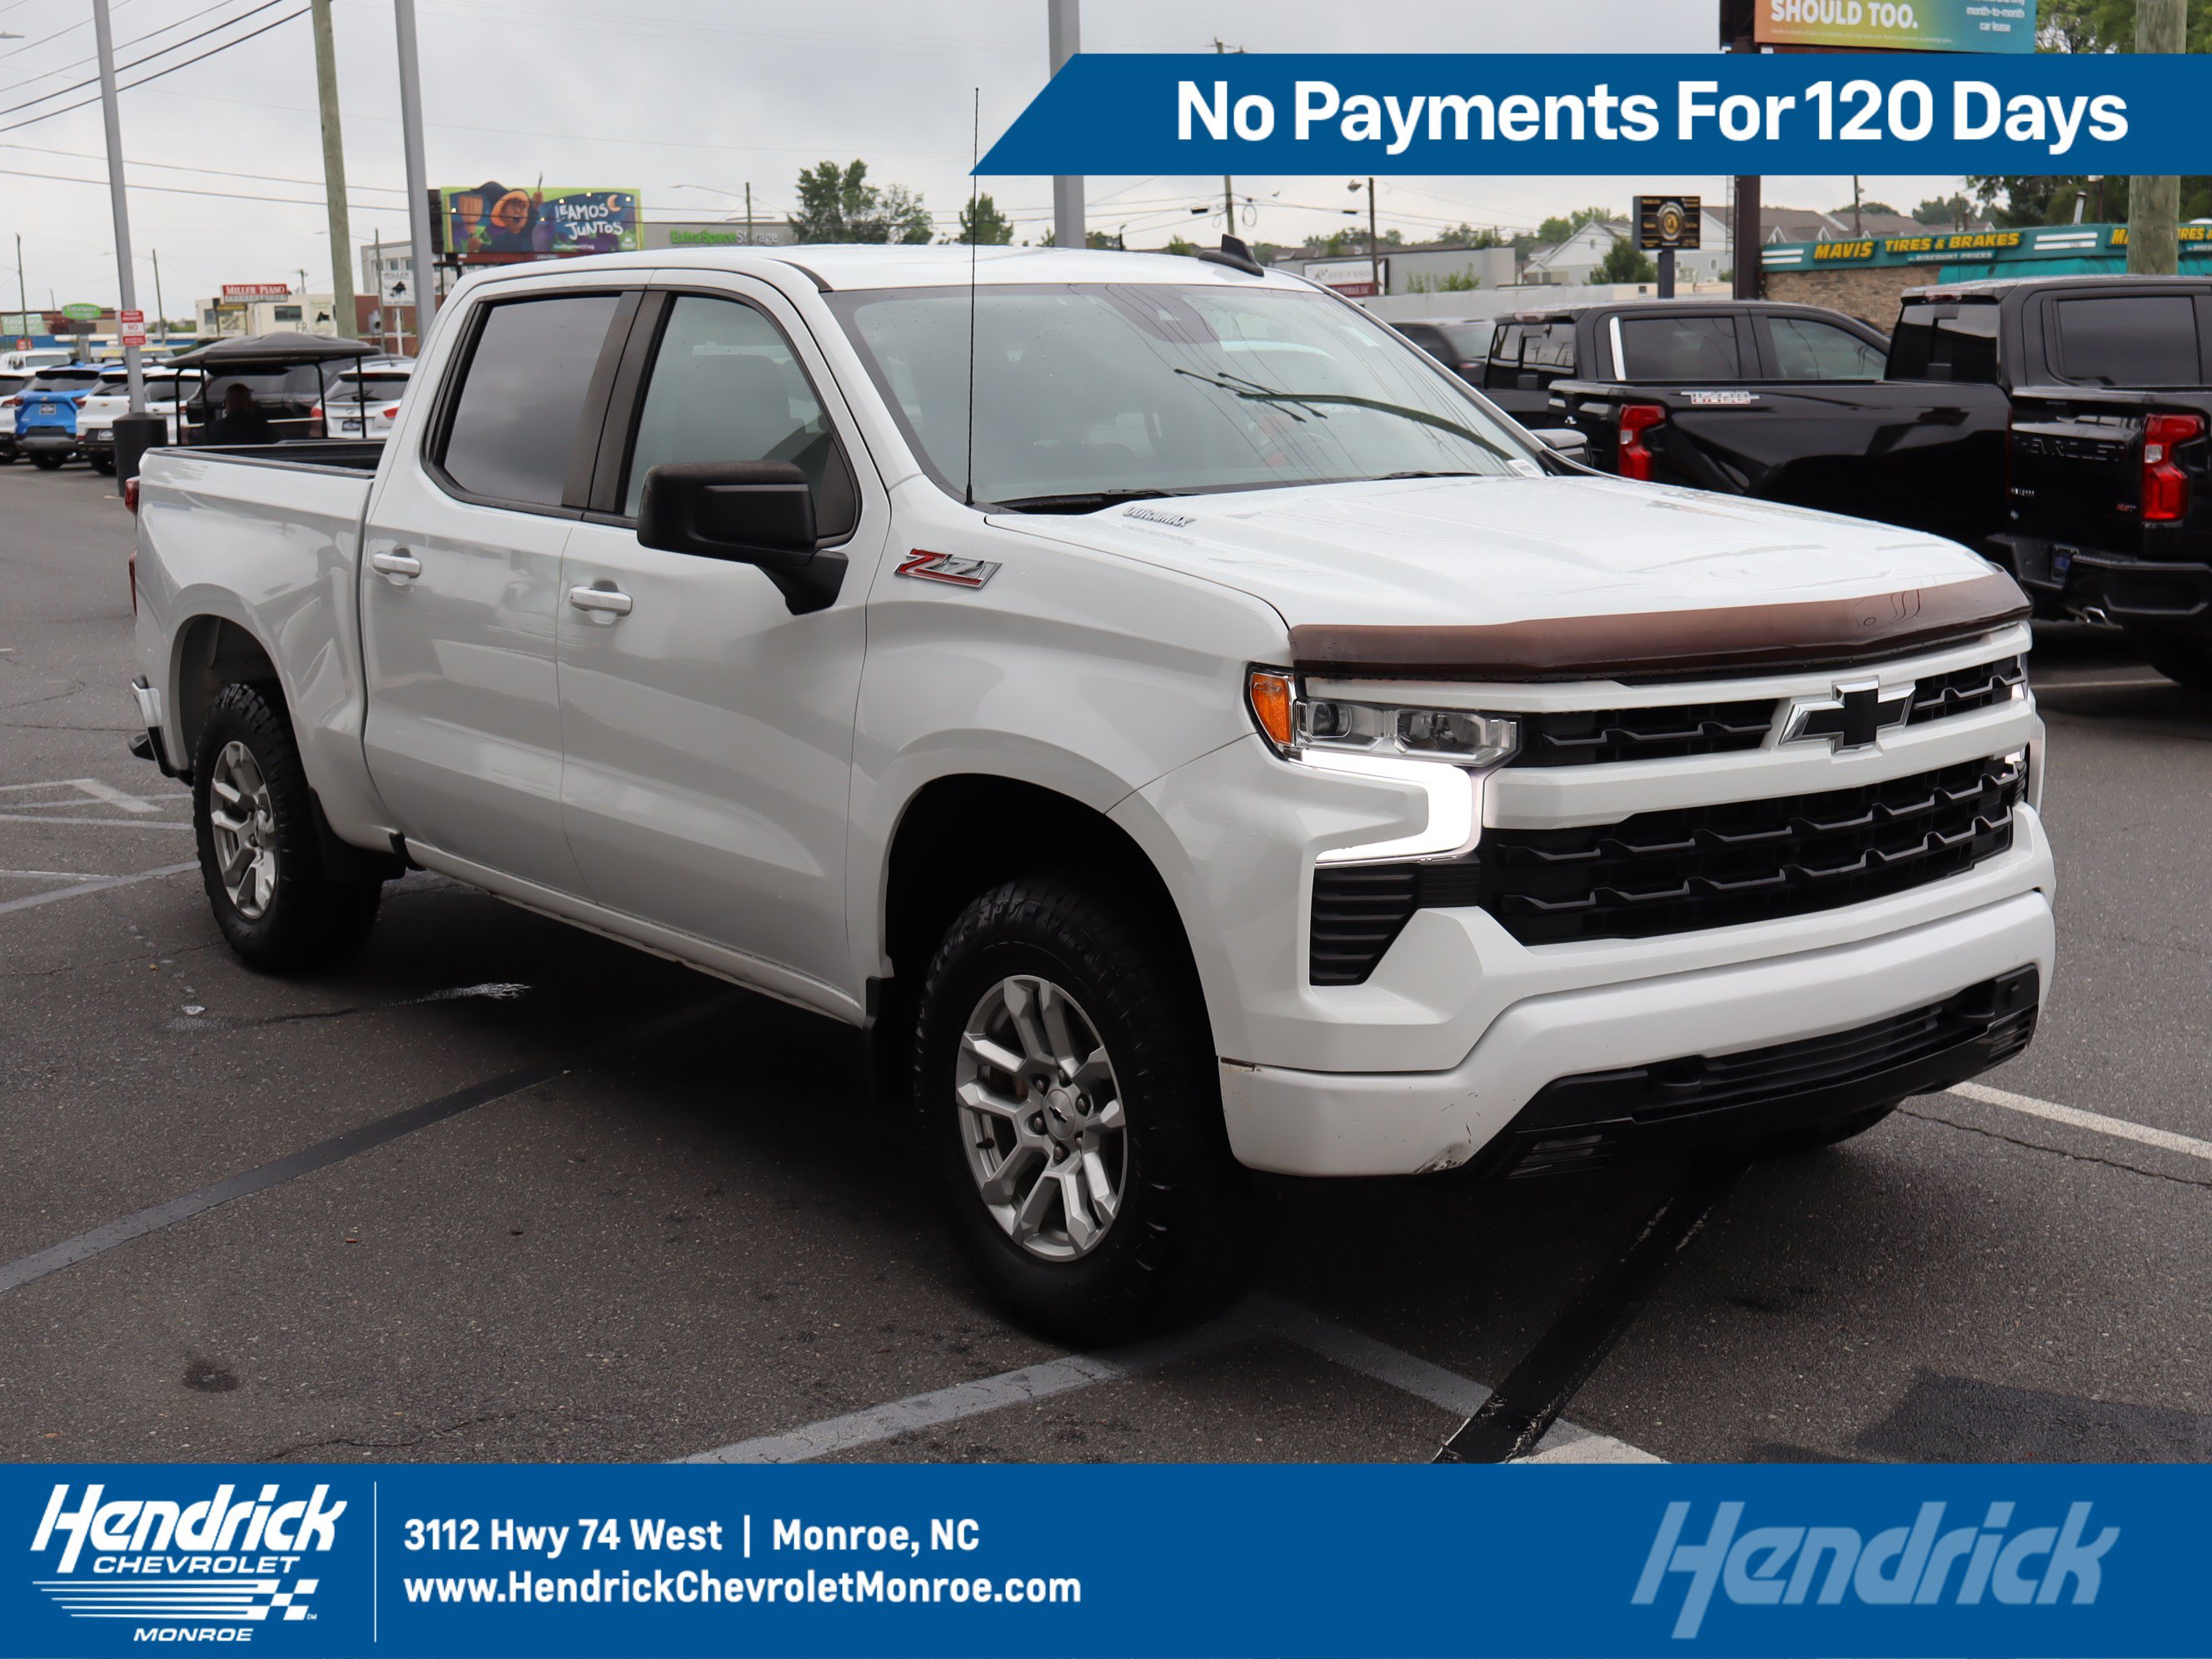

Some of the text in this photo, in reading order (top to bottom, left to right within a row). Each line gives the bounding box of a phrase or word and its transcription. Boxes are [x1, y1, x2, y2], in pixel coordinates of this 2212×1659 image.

[1771, 0, 1918, 29] SHOULD TOO.
[1814, 232, 2021, 260] MAVIS TIRES & BRAKES
[2178, 227, 2205, 241] IRES
[1916, 252, 1958, 262] DISCOUNT
[1960, 251, 1994, 259] PRICES
[894, 547, 1003, 590] Z71
